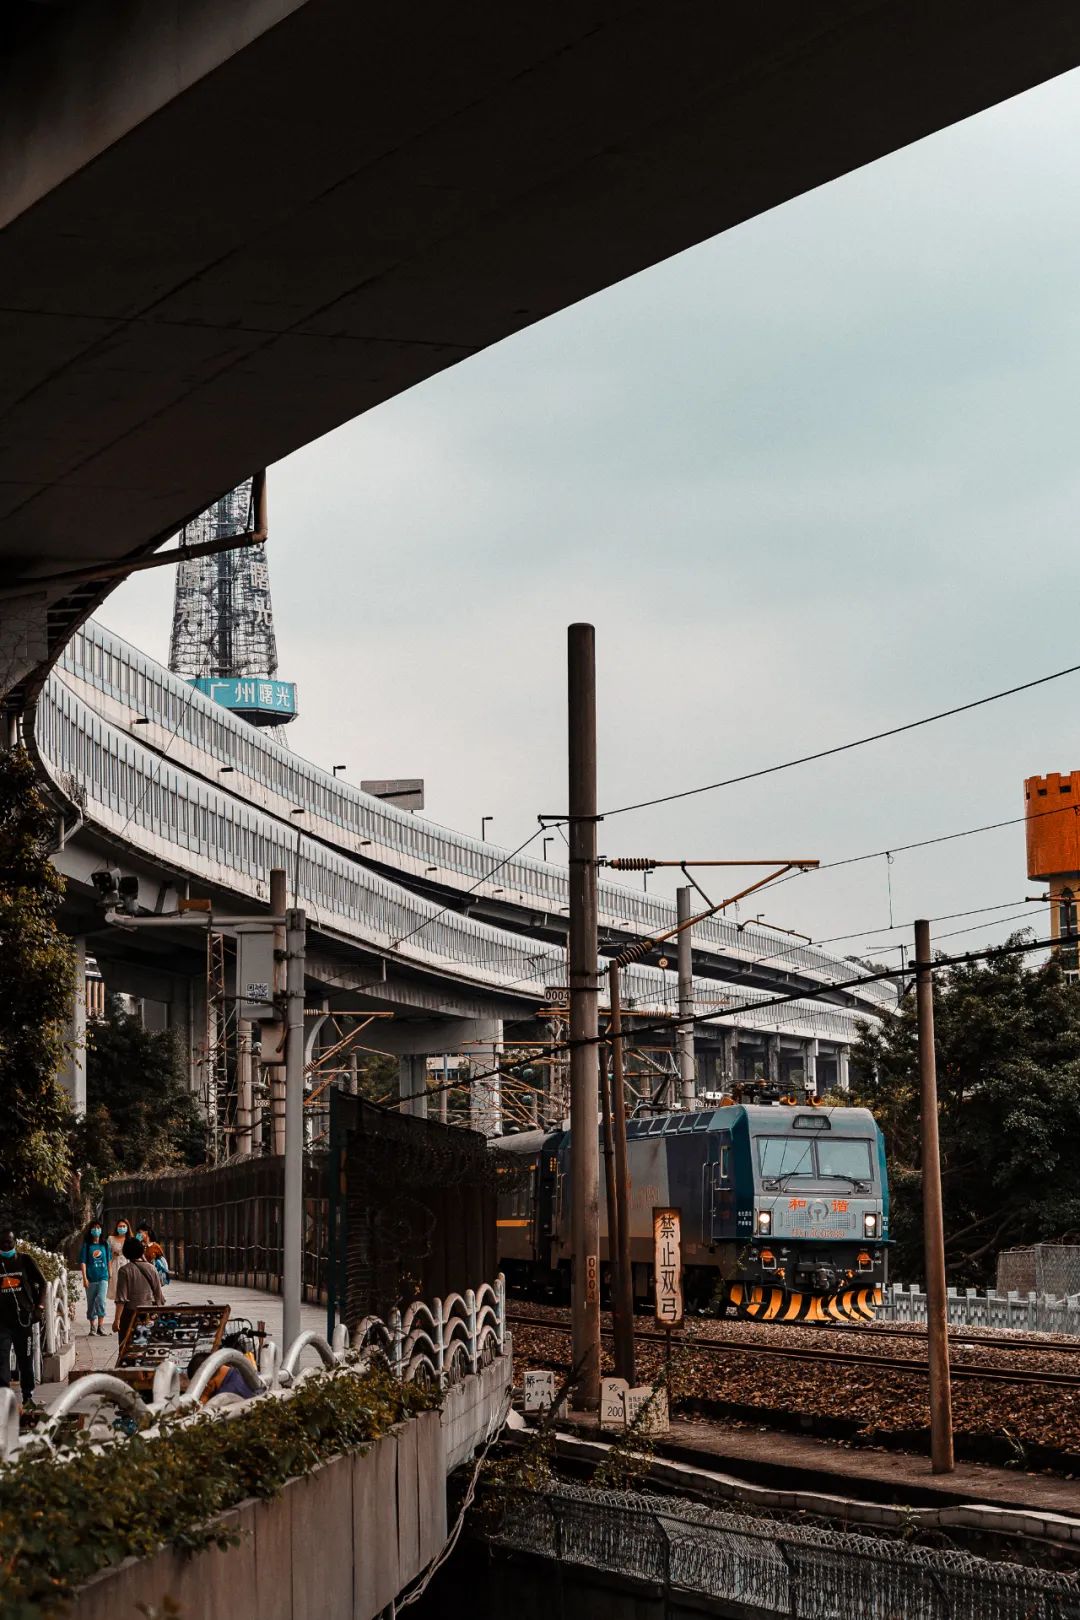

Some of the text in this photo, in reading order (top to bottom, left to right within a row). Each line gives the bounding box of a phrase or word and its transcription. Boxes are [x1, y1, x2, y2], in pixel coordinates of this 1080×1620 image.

[210, 681, 290, 707] 广州曙光
[788, 1198, 849, 1212] 和 谐
[660, 1214, 677, 1322] 禁止双弓
[607, 1406, 624, 1418] 200
